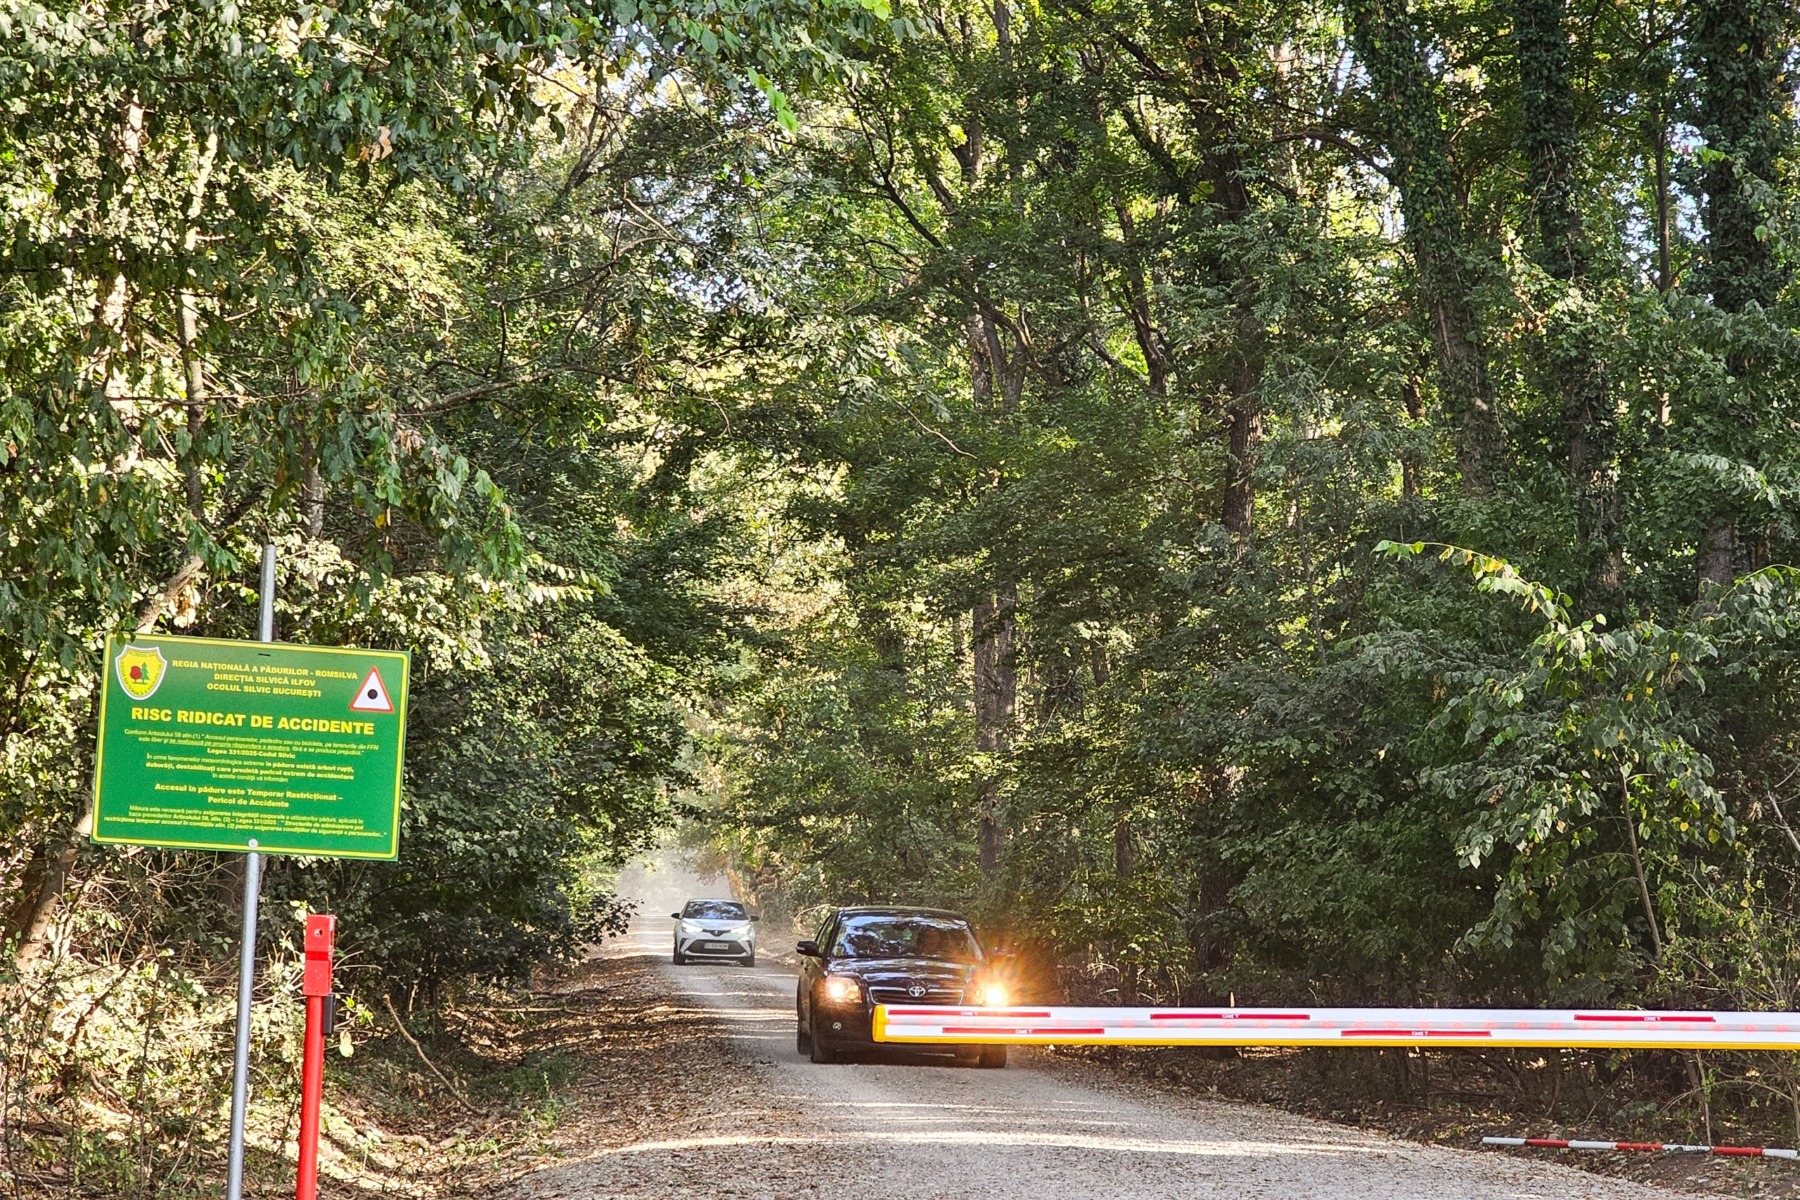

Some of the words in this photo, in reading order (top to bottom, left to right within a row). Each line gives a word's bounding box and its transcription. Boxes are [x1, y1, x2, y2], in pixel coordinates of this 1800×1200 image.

[172, 660, 199, 668] REGIA
[260, 665, 309, 676] PĂDURILOR
[315, 670, 358, 680] ROMSILVA
[256, 675, 289, 685] SILVICĂ
[291, 678, 316, 687] ILFOV
[207, 682, 242, 691] OCOLUL
[243, 685, 271, 694] SILVIC
[131, 707, 172, 722] RISC
[177, 710, 246, 727] RIDICAT
[250, 715, 273, 729] DE
[277, 717, 374, 735] ACCIDENTE
[207, 747, 228, 755] Legea
[155, 783, 188, 791] Accesul
[198, 786, 226, 795] pădure
[247, 789, 285, 799] Temporar
[208, 796, 236, 804] Pericol
[249, 799, 289, 808] Accidente
